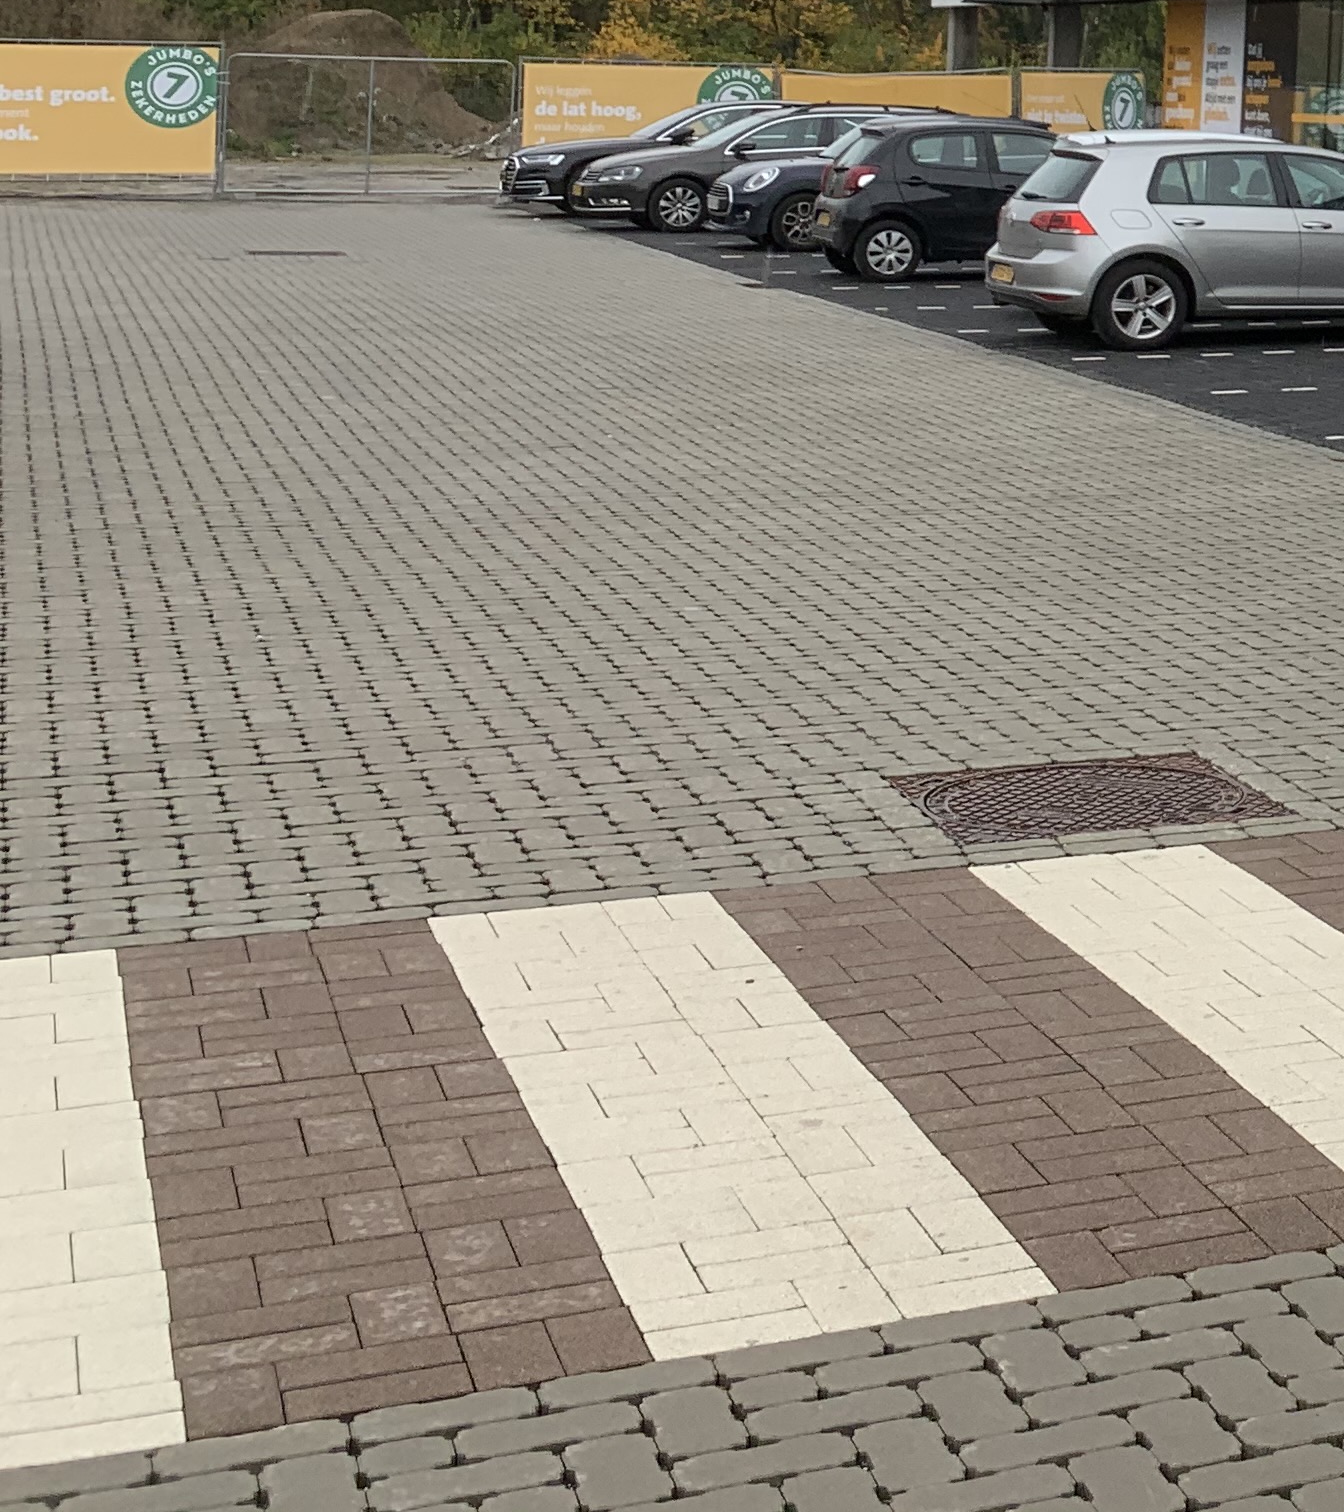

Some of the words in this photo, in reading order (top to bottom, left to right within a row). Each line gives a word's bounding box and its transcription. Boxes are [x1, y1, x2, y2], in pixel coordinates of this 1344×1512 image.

[148, 47, 217, 77] JUMBO'S
[162, 71, 190, 100] 7
[714, 68, 771, 94] JUMBO'S
[49, 85, 116, 107] groot.
[130, 80, 217, 125] ZEKERHEDEN
[534, 99, 558, 116] de
[562, 100, 587, 116] lat
[591, 100, 642, 121] hoog,
[0, 124, 39, 142] ok.
